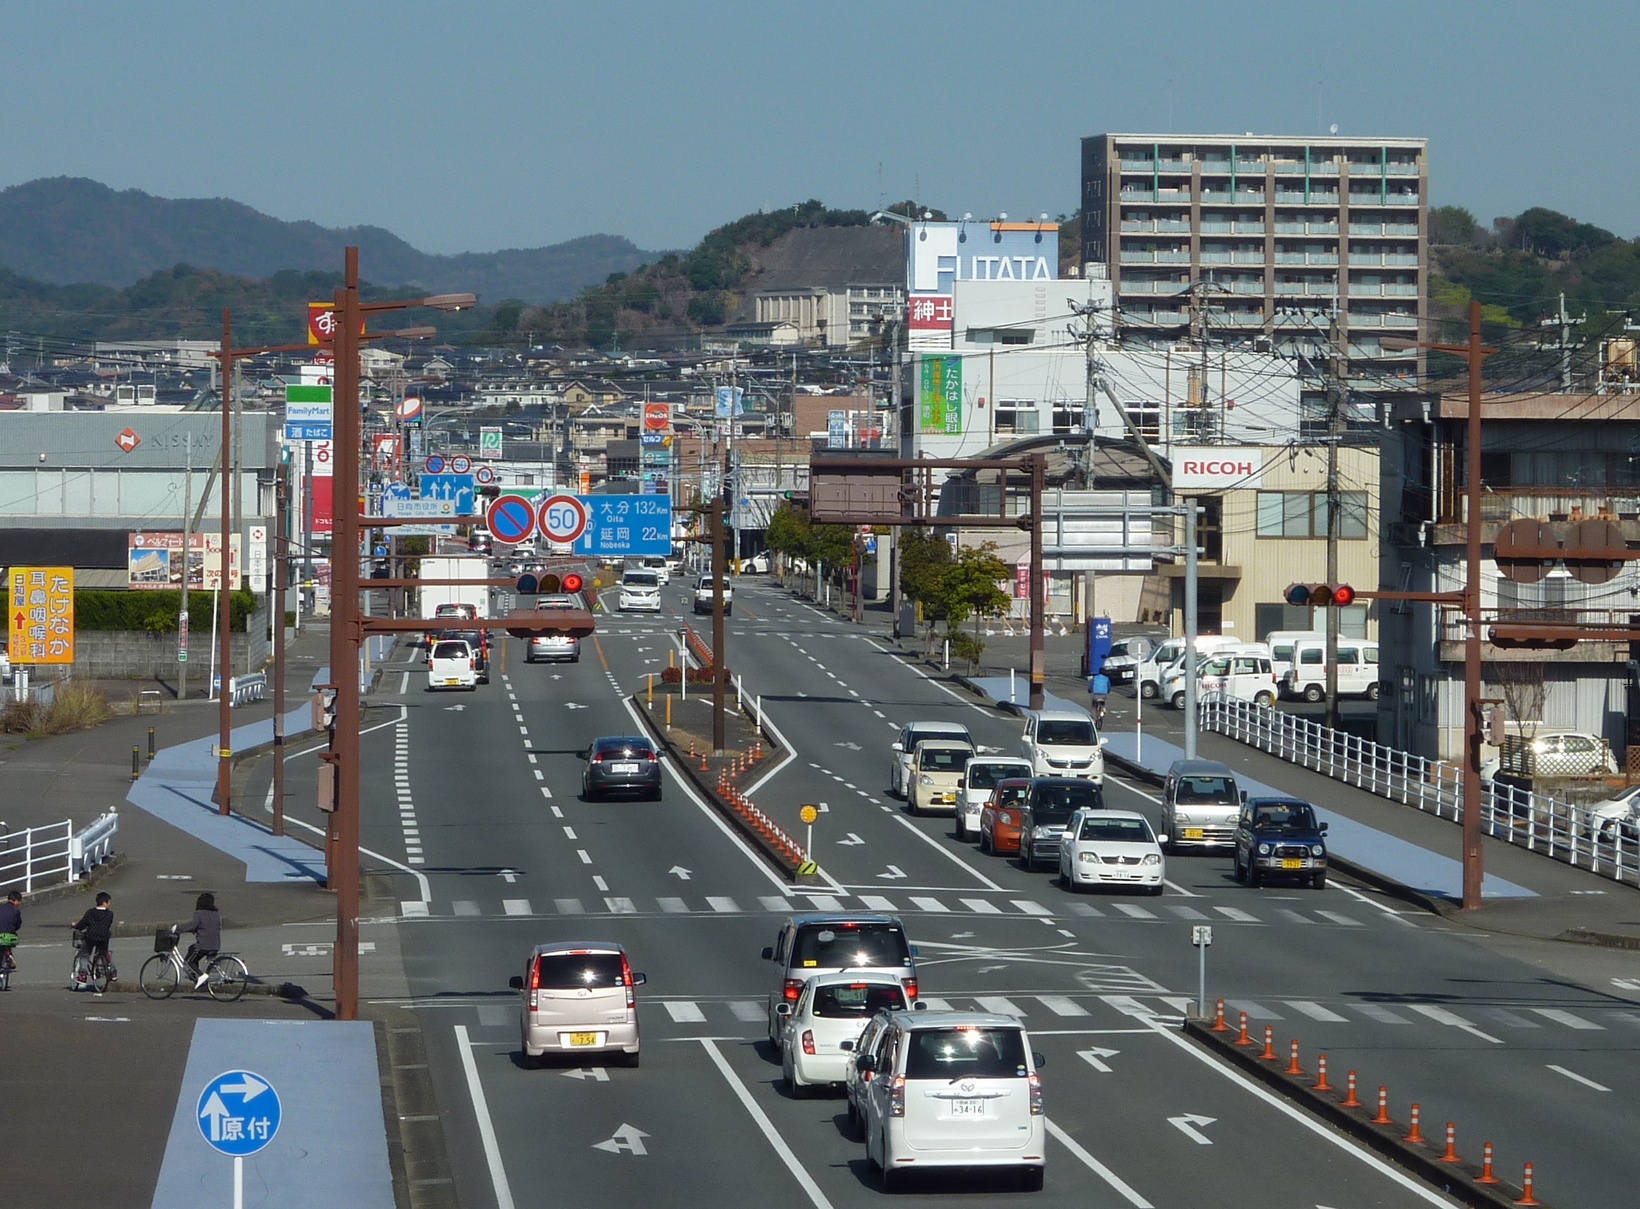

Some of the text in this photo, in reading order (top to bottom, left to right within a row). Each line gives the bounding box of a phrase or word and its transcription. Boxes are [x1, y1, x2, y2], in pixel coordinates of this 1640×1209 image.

[945, 368, 959, 434] たかはし眼科
[288, 407, 329, 416] FamilyMart
[306, 428, 328, 437] たばこ
[642, 435, 661, 443] セルフ
[1183, 461, 1252, 475] RICOH
[397, 503, 438, 511] 日向市役所
[600, 501, 630, 515] 大分
[549, 508, 575, 530] 50
[606, 515, 624, 523] Oita
[600, 527, 630, 541] 延岡
[600, 541, 630, 549] Nobeoka
[29, 571, 47, 658] 耳鼻咽喉科
[50, 575, 69, 655] たけなか
[222, 1117, 271, 1141] 原付
